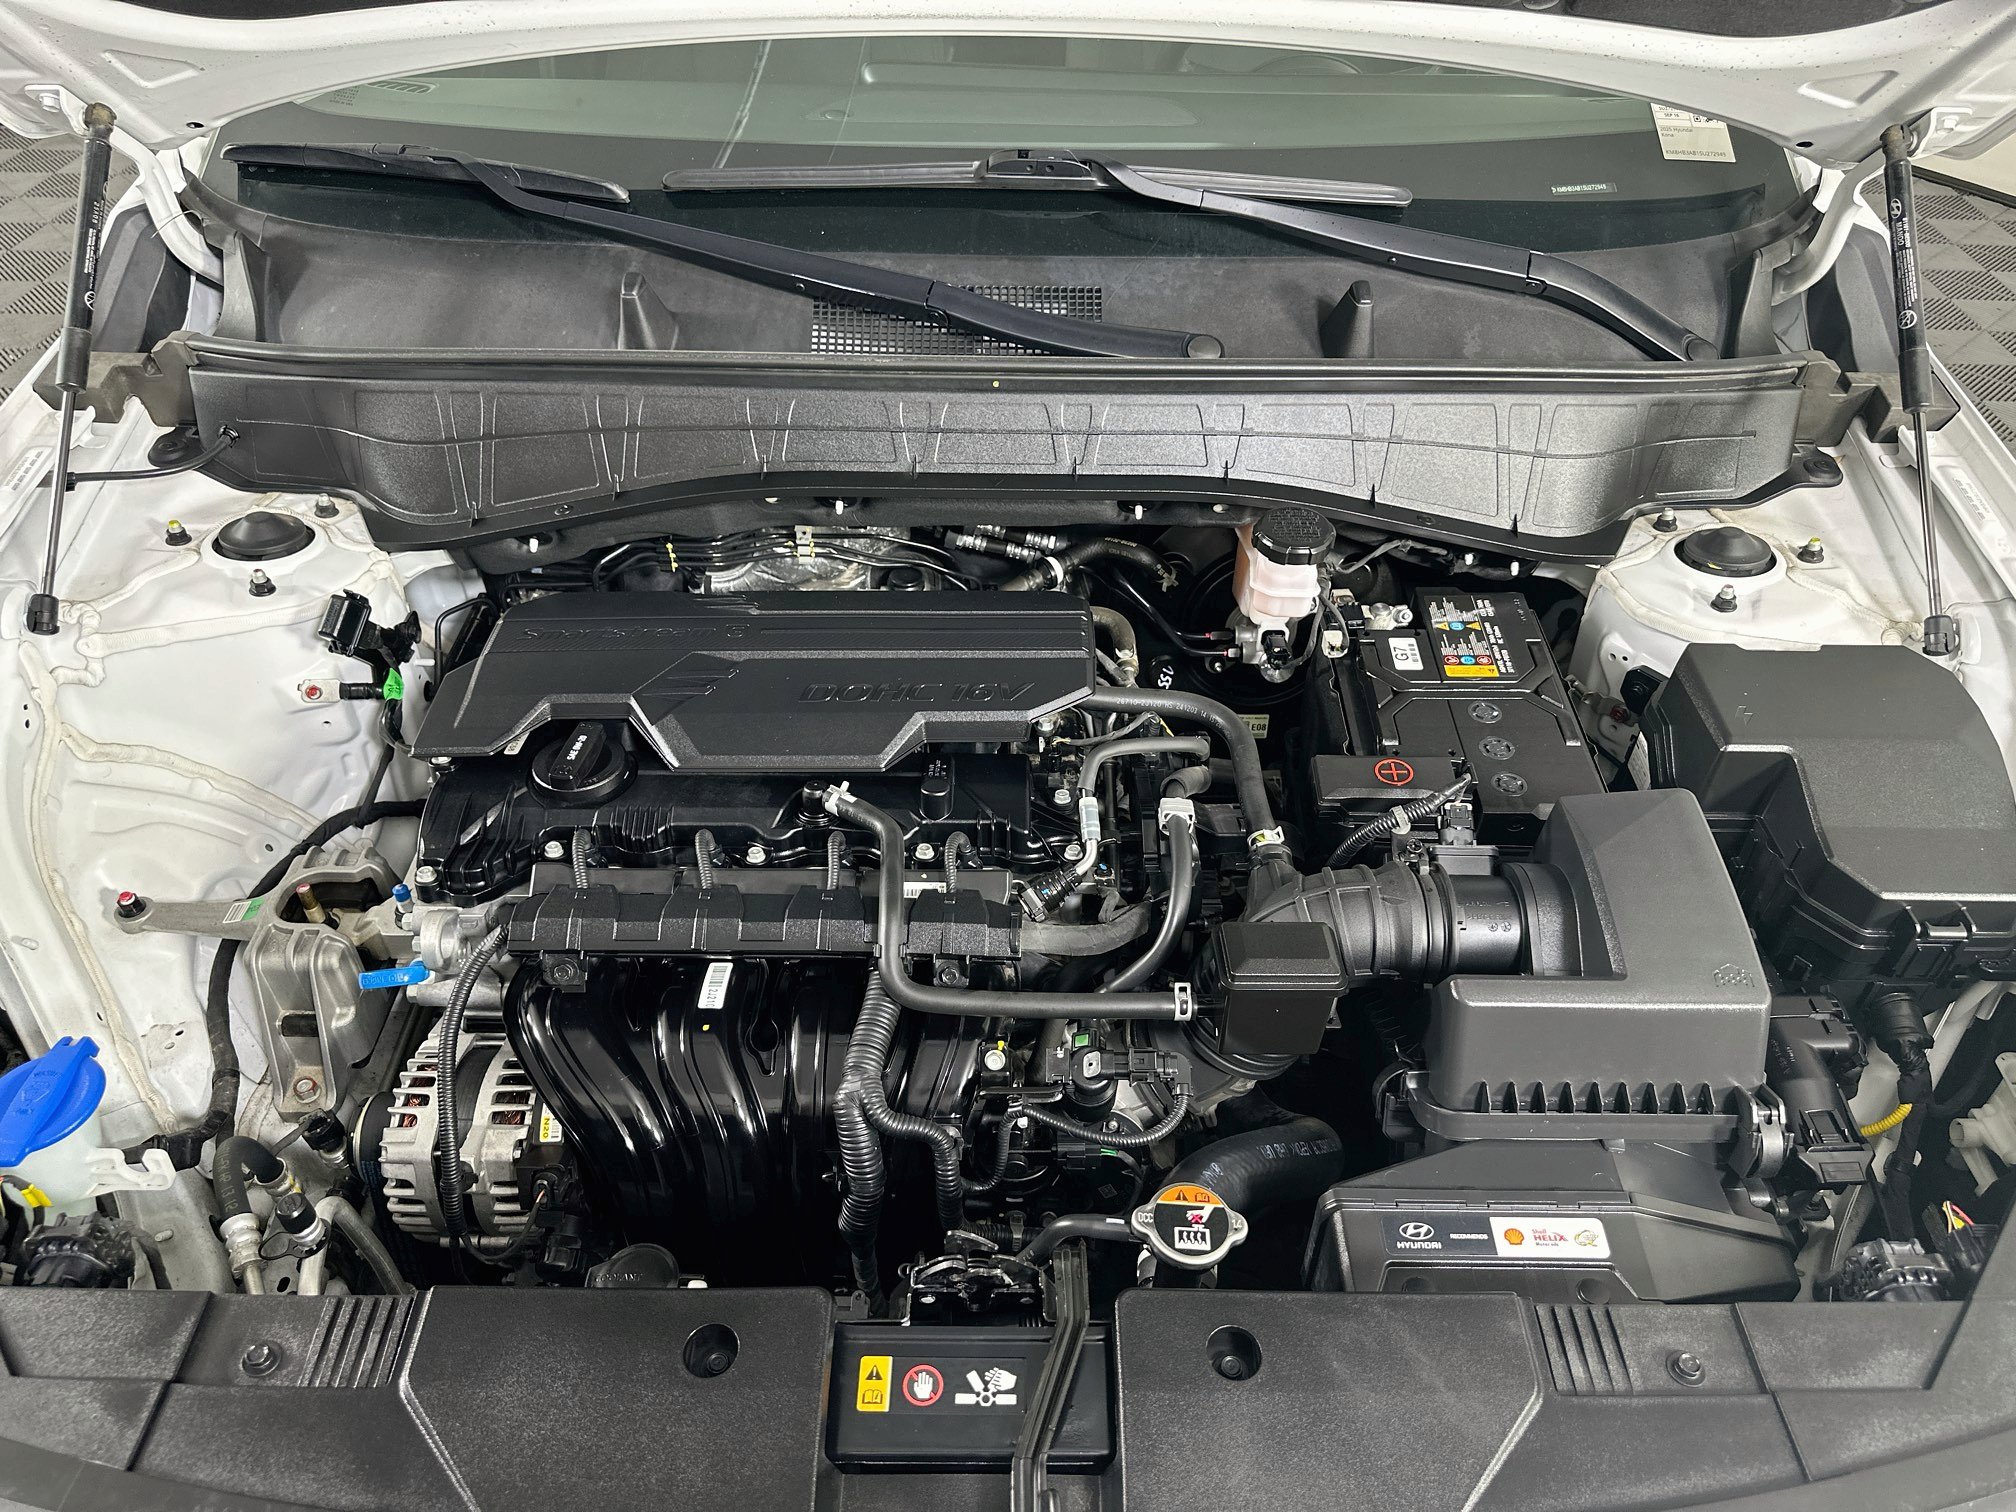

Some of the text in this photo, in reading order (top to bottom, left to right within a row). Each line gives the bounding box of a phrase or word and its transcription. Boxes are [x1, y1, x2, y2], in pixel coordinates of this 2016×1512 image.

[1896, 221, 1905, 246] MANDO
[1393, 646, 1409, 661] G7
[799, 682, 1036, 702] DOHC 16V
[1251, 723, 1267, 731] E08
[566, 749, 579, 760] SAE
[542, 1117, 550, 1139] N20
[1138, 1212, 1154, 1223] DCC
[1533, 1232, 1568, 1242] HELIX
[1396, 1241, 1442, 1249] HYUNDAI
